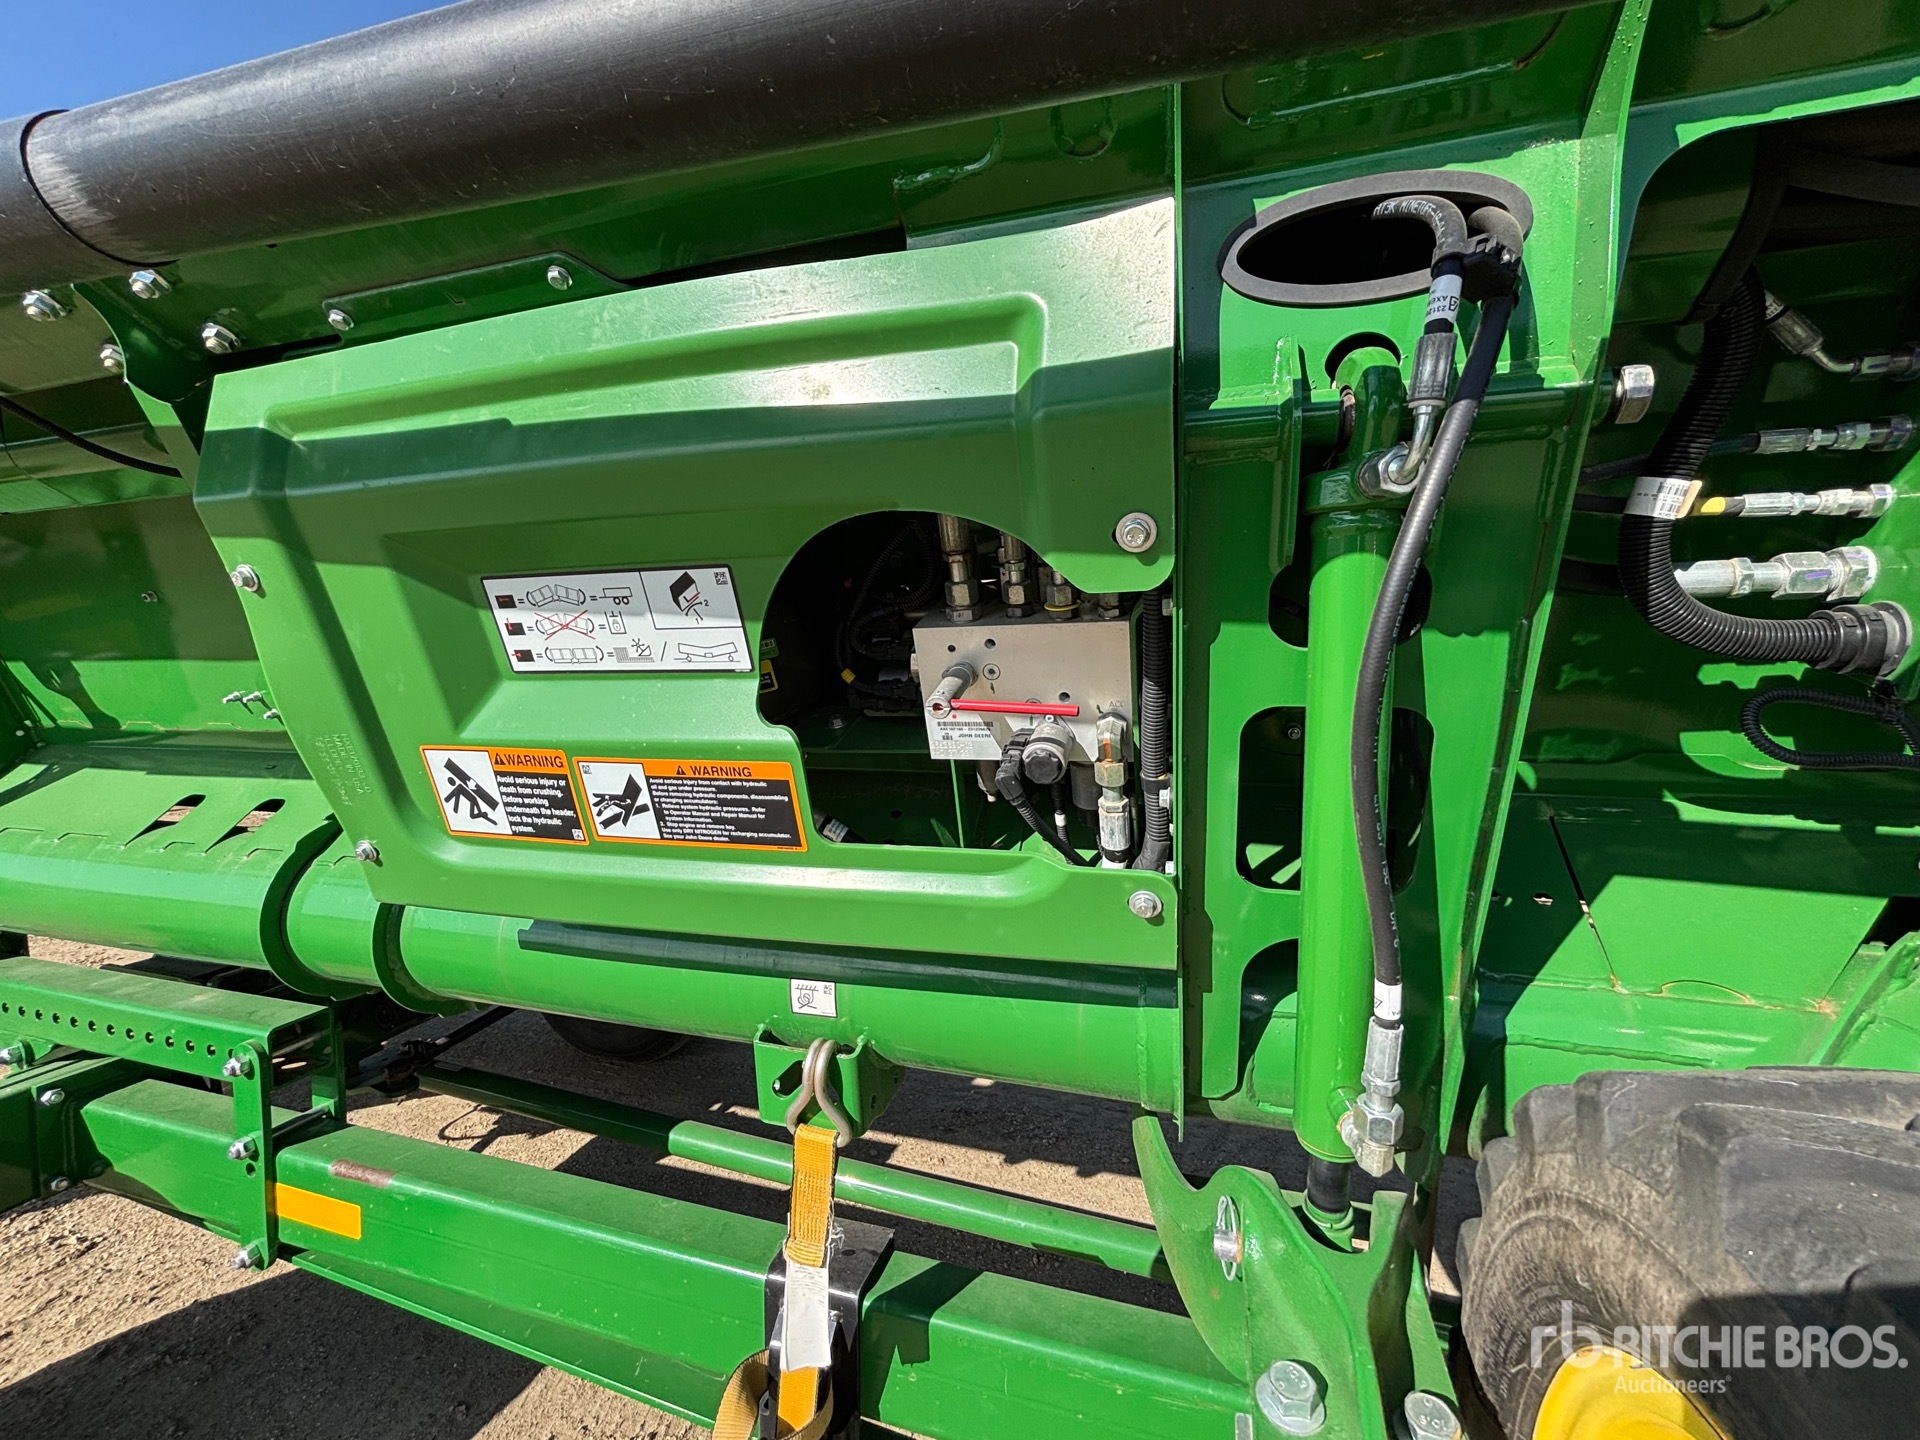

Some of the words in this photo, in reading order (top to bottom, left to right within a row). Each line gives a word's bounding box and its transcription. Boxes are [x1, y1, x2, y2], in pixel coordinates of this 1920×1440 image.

[503, 754, 564, 768] WARNING
[690, 765, 752, 777] WARNING
[497, 775, 514, 783] Avoid
[515, 776, 538, 785] serious
[539, 777, 557, 787] injury
[517, 786, 532, 794] from
[533, 788, 563, 798] crushing.
[502, 795, 523, 803] Before
[523, 797, 549, 806] working
[505, 806, 540, 814] underneath
[552, 808, 576, 817] header,
[522, 815, 532, 823] the
[533, 817, 562, 825] hydraulic
[512, 825, 536, 833] system.
